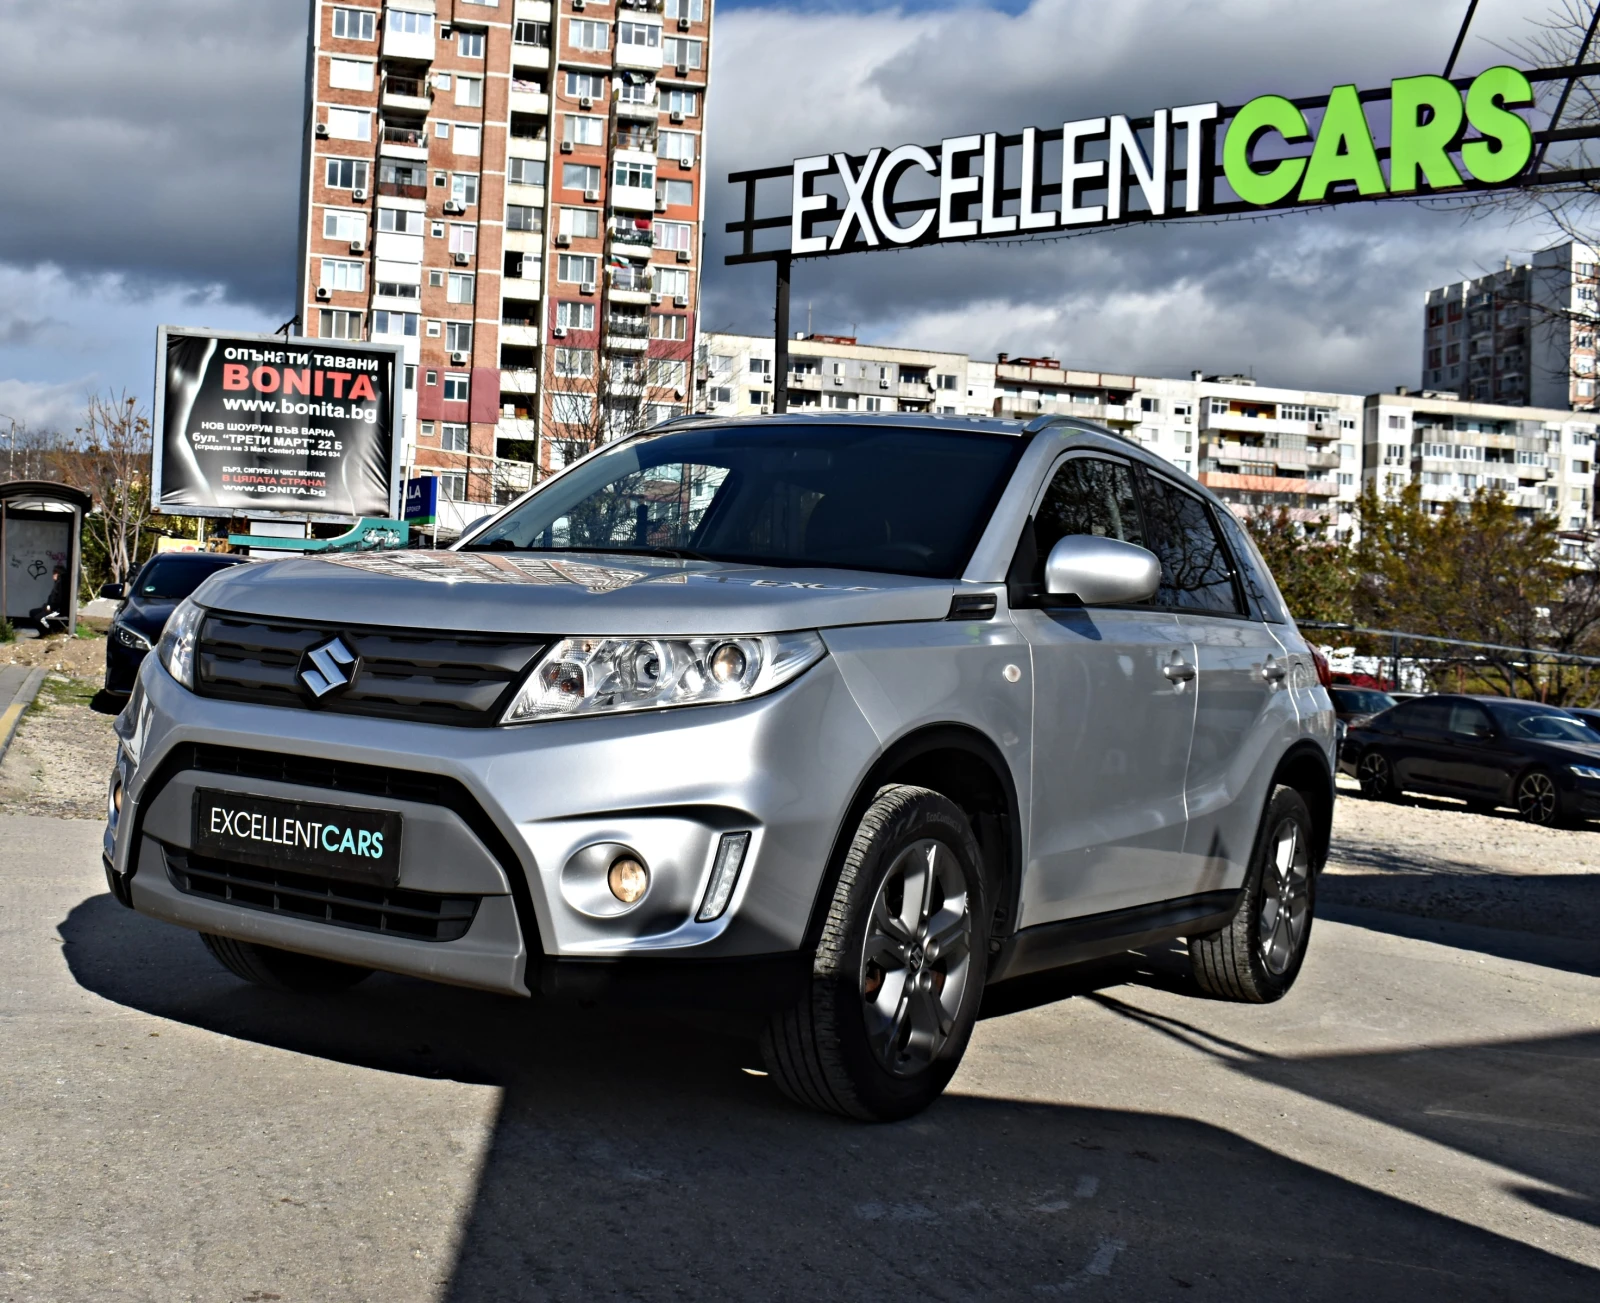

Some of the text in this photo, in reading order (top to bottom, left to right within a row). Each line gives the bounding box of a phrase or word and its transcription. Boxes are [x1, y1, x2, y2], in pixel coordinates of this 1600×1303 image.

[224, 347, 379, 371] опънати тавани
[223, 398, 377, 424] www.bonita.bg
[201, 421, 336, 437] НОВ ШОУРУМ ВЪВ ВАРНА
[192, 432, 219, 443] бул.
[317, 439, 332, 450] 22
[334, 441, 343, 450] Б
[222, 474, 326, 487] В ЦЯЛАТА СТРАНА!
[222, 484, 326, 497] www.BONITA.bg
